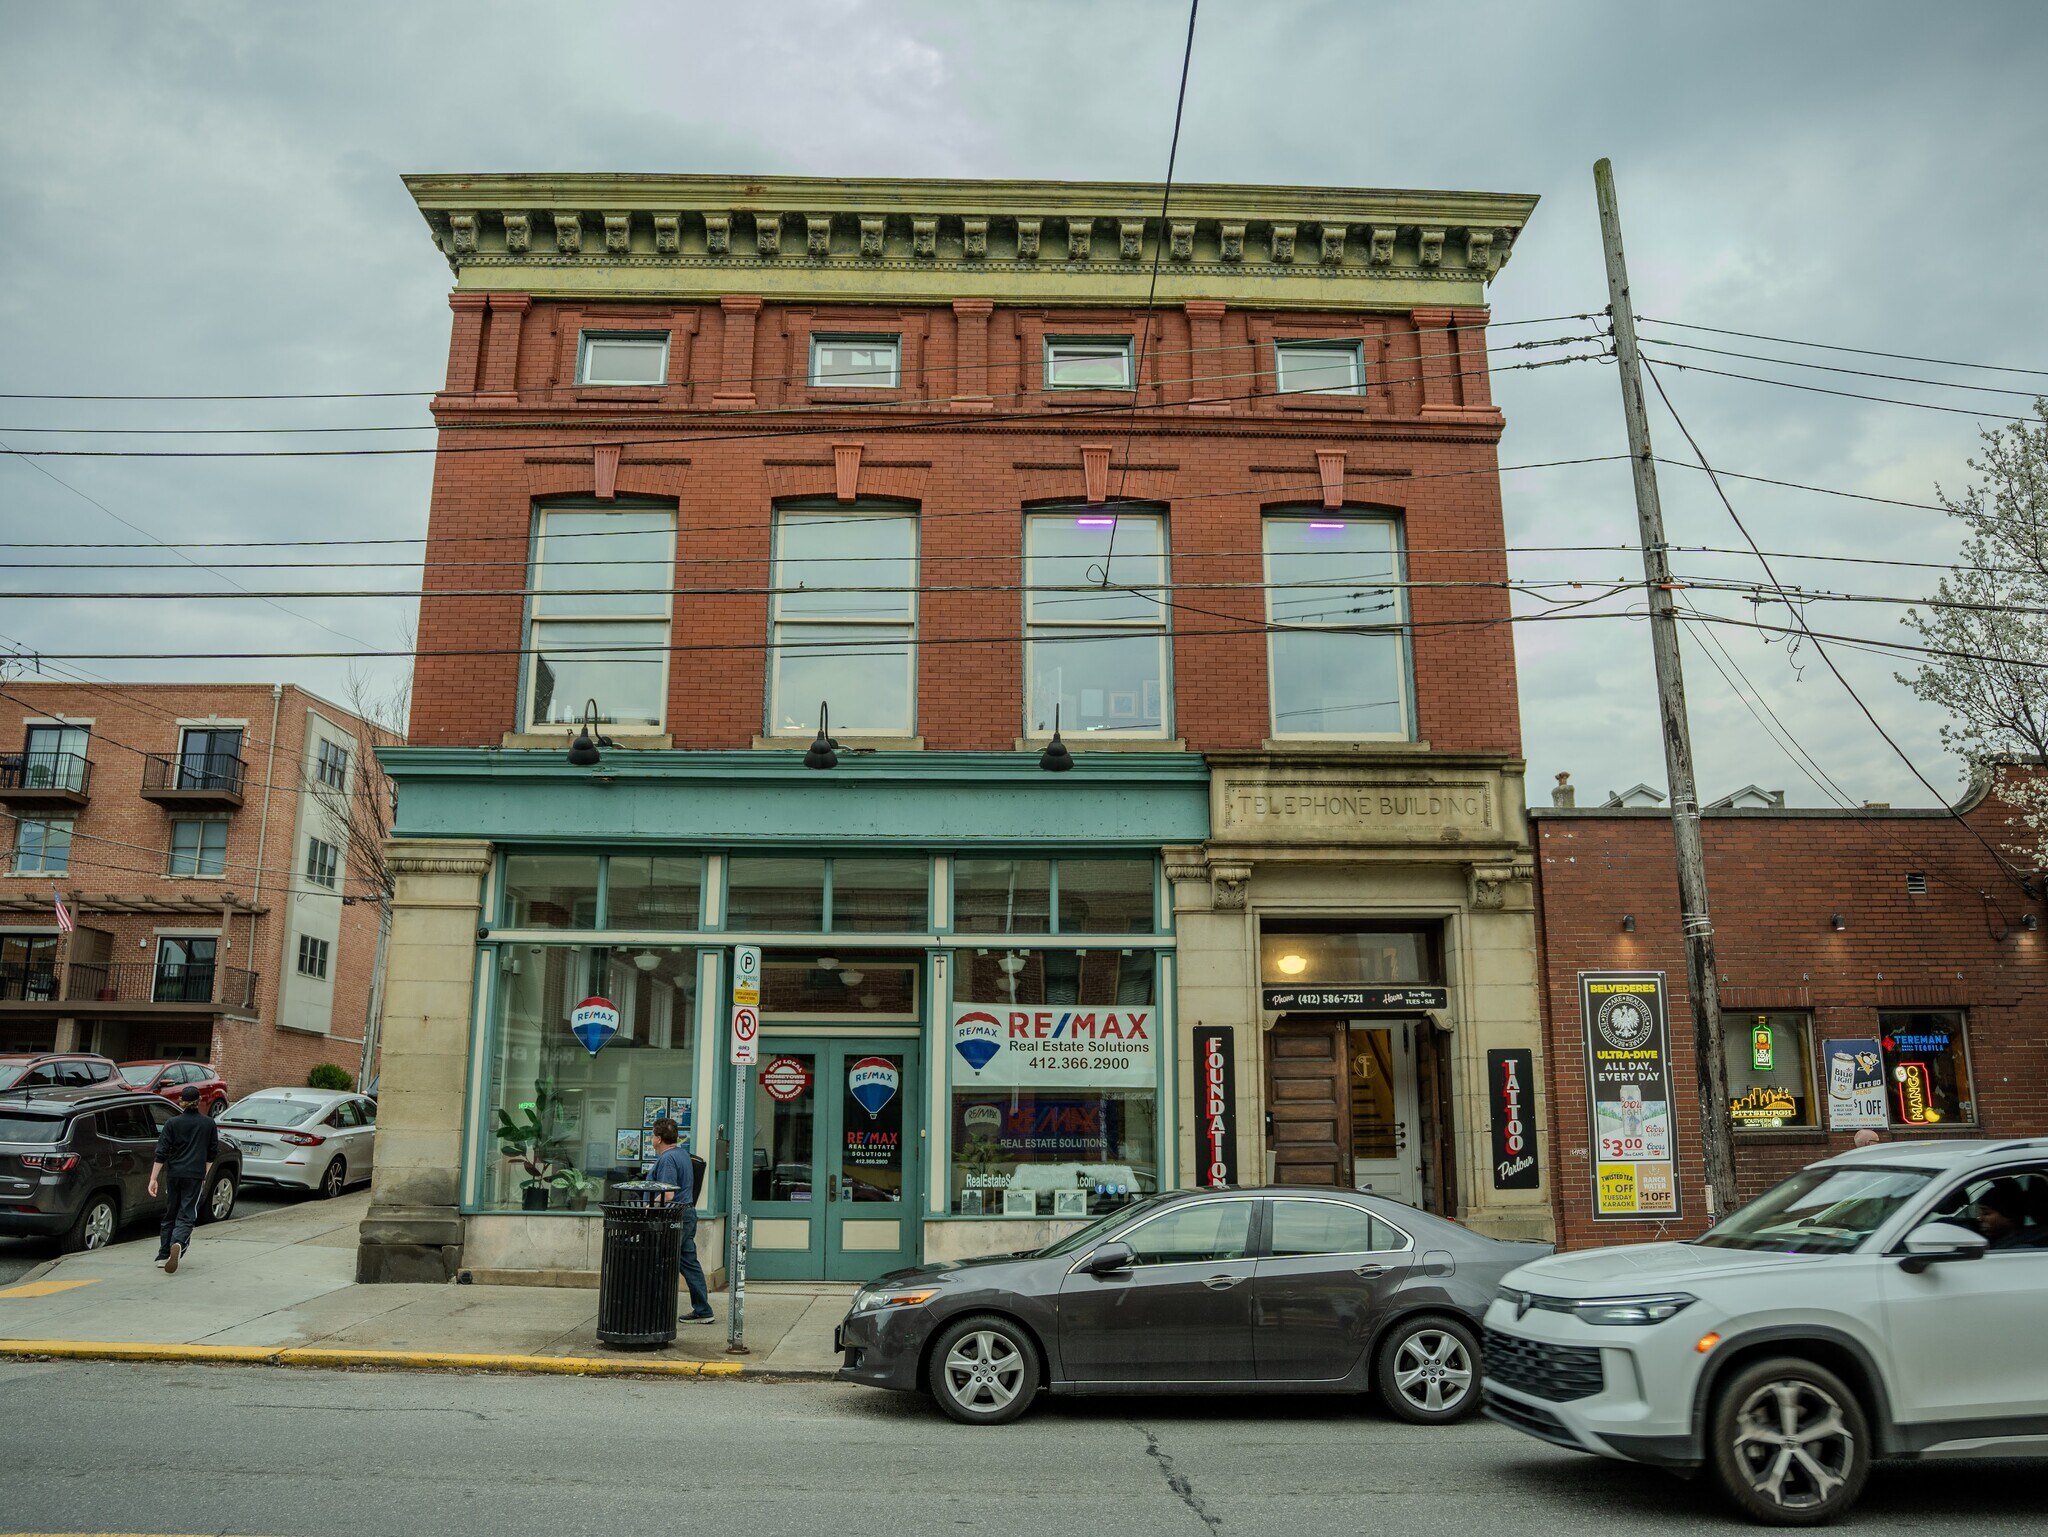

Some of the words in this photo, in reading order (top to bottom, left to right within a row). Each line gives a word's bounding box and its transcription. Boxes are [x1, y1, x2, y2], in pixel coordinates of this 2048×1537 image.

[1238, 796, 1372, 815] TELEPHONE
[1380, 797, 1478, 816] BUILDING
[1590, 984, 1656, 993] BELVEDERES
[1272, 994, 1294, 1005] Phone
[1298, 994, 1320, 1005] (412)
[1322, 994, 1363, 1004] 586-7521
[1383, 993, 1403, 1004] Hours
[577, 1011, 614, 1022] RE/MAX
[1009, 1012, 1149, 1040] RE/MAX
[959, 1027, 998, 1038] RE/MAX
[1894, 1035, 1949, 1044] TEREMANA
[1009, 1041, 1038, 1052] Real
[1043, 1041, 1084, 1052] Estate
[1088, 1041, 1150, 1053] Solutions
[1914, 1044, 1944, 1052] TEQUILA
[1597, 1050, 1658, 1060] ULTRA-DIVE
[769, 1060, 782, 1072] BUY
[782, 1060, 802, 1073] LOCAL
[1029, 1057, 1129, 1070] 412.366.2900
[1604, 1062, 1626, 1070] ALL
[1628, 1062, 1652, 1072] DAY,
[855, 1072, 893, 1082] RE/MAX
[1598, 1072, 1635, 1082] EVERY
[1638, 1072, 1660, 1081] DAY
[1834, 1076, 1852, 1084] LIGHT
[1855, 1081, 1872, 1090] LET'S
[1907, 1066, 1924, 1120] MANGO
[1503, 1060, 1524, 1152] TATTOO
[1866, 1100, 1882, 1115] OFF
[847, 1132, 898, 1144] RE/MAX
[1000, 1138, 1023, 1148] REAL
[1025, 1138, 1057, 1148] ESTATE
[1059, 1138, 1108, 1148] SOLUTIONS
[1498, 1155, 1534, 1180] Parlour
[1601, 1174, 1623, 1182] TWISTED
[1624, 1174, 1632, 1182] TEA
[1615, 1184, 1634, 1192] OFF
[1640, 1192, 1649, 1200] $1
[1652, 1192, 1671, 1201] OFF
